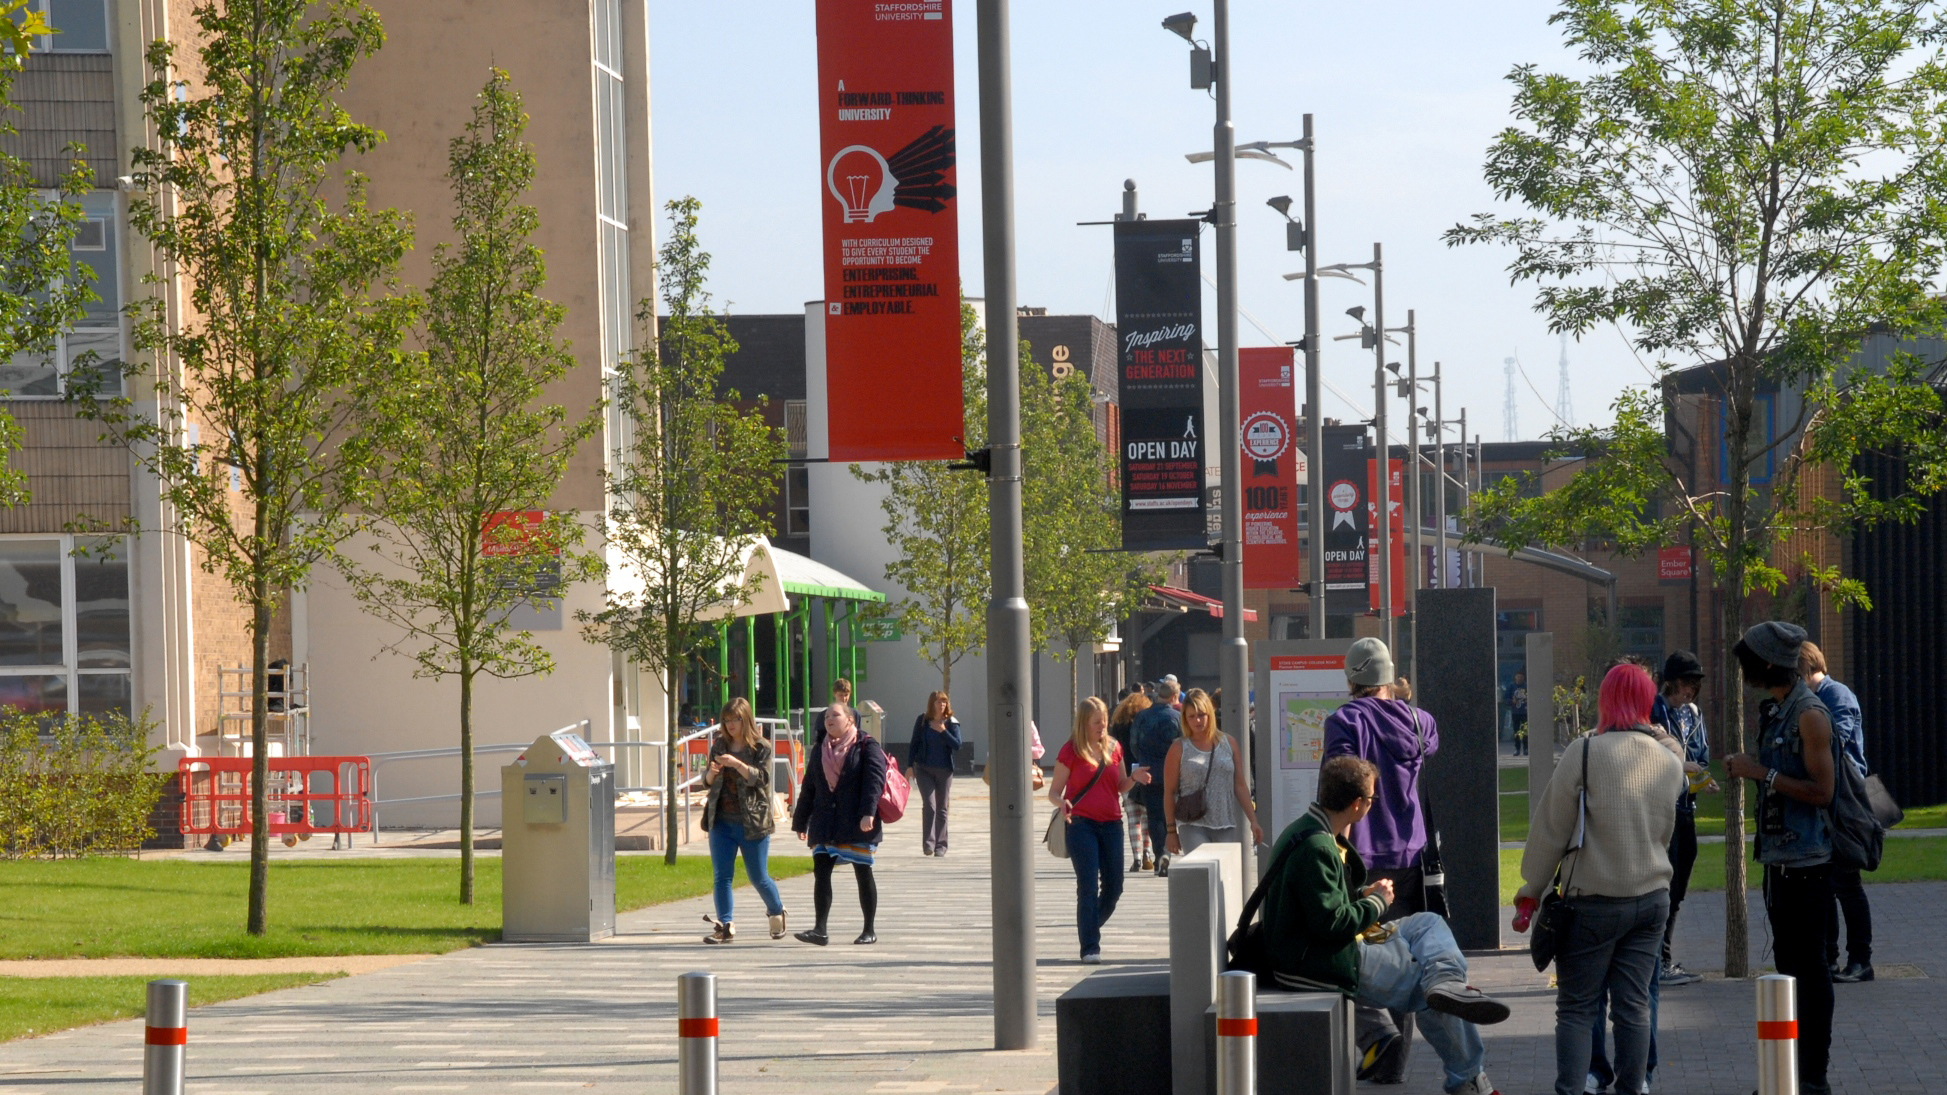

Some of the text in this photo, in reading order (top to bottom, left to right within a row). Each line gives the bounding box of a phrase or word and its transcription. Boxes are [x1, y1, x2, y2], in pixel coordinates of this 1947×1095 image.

[875, 3, 942, 12] STAFFORDSHIRE
[875, 12, 923, 21] UNIVERSITY
[838, 79, 845, 92] A
[838, 91, 945, 107] FORWARD THINKING
[838, 108, 892, 121] UNIVERSITY
[842, 237, 933, 248] WITH CURRICULUM DESIGNED
[842, 246, 930, 257] TO GIVE EVERY STUDENT THE
[842, 255, 922, 266] OPPORTUNITY TO BECOME
[1125, 323, 1196, 353] Inspiring
[1133, 349, 1187, 364] THE NEXT
[1126, 364, 1195, 380] GENERATION
[1128, 441, 1197, 460] OPEN DAY
[1128, 463, 1155, 471] SATURDAY
[1165, 461, 1198, 470] SEPTEMBER
[1132, 473, 1159, 481] SATURDAY
[1169, 471, 1194, 480] OCTOBER
[1130, 483, 1157, 491] SATURDAY
[1167, 481, 1197, 490] NOVEMBER
[1245, 486, 1279, 511] 100
[1280, 486, 1288, 510] YEARS
[1245, 511, 1288, 521] experience
[1325, 550, 1365, 562] OPEN DAY
[1661, 569, 1688, 577] Square
